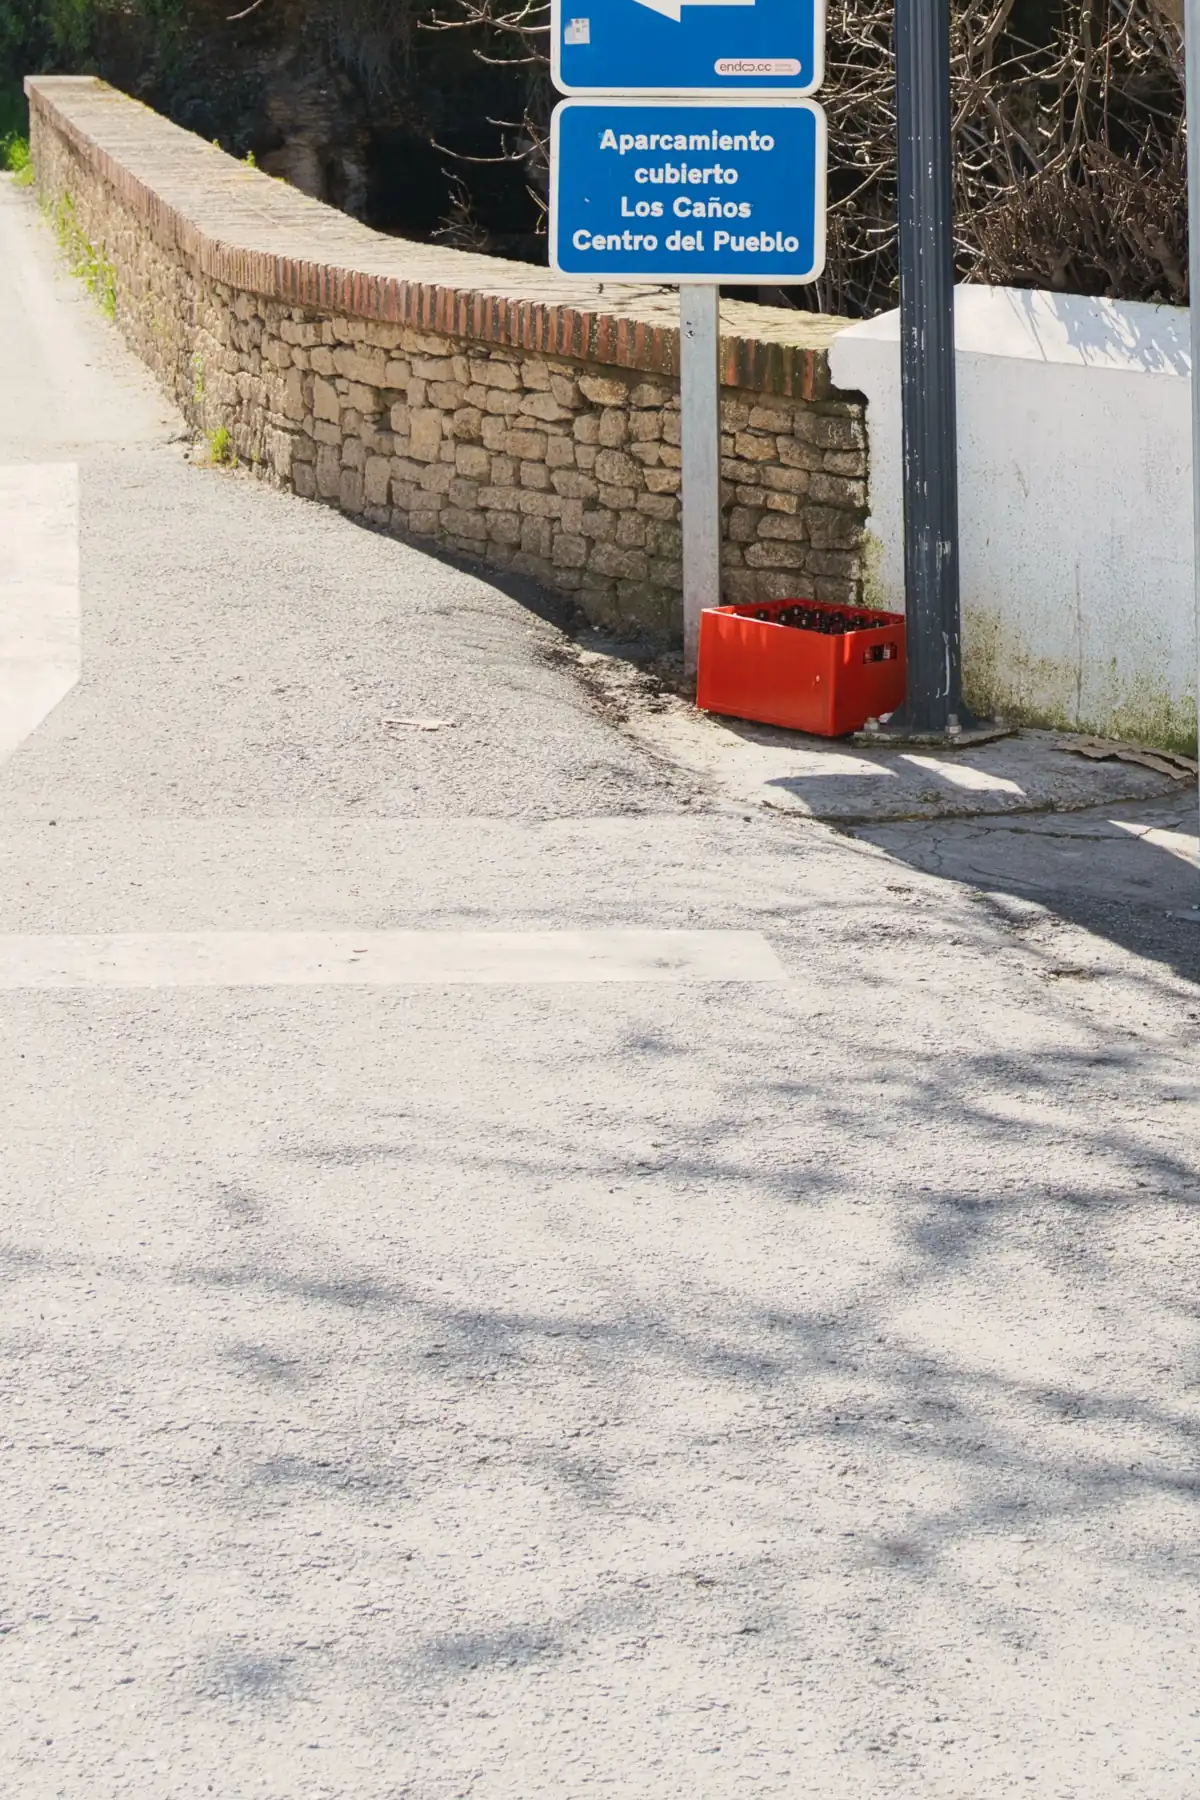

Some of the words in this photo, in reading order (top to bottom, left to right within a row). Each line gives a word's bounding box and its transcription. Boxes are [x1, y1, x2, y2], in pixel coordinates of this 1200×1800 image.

[600, 129, 775, 155] Aparcamiento
[634, 163, 739, 185] cubierto
[621, 196, 664, 217] Los
[673, 196, 751, 218] Caños
[572, 229, 659, 251] Centro
[665, 231, 705, 252] del
[713, 231, 799, 253] Pueblo
